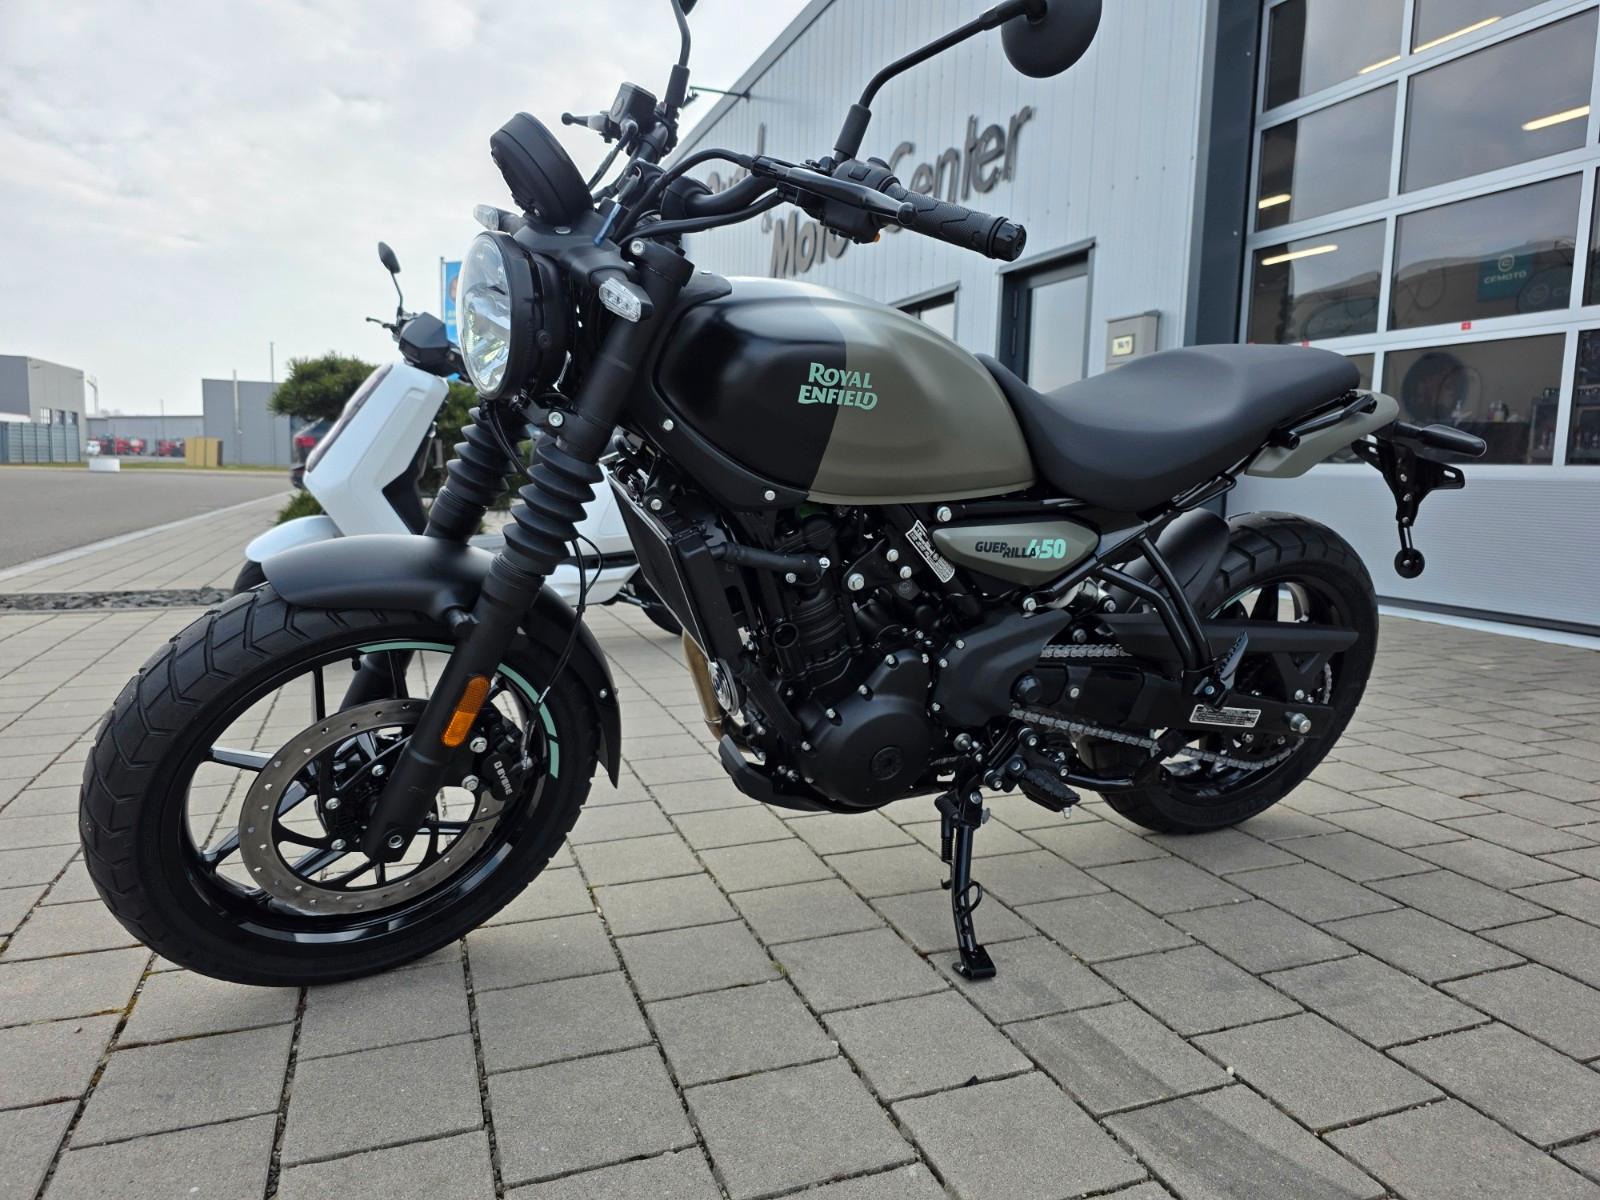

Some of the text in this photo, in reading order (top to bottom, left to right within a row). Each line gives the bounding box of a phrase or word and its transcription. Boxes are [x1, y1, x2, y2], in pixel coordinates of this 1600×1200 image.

[808, 362, 873, 388] ROYAL
[798, 385, 878, 410] ENFIELD
[1026, 538, 1067, 559] 450
